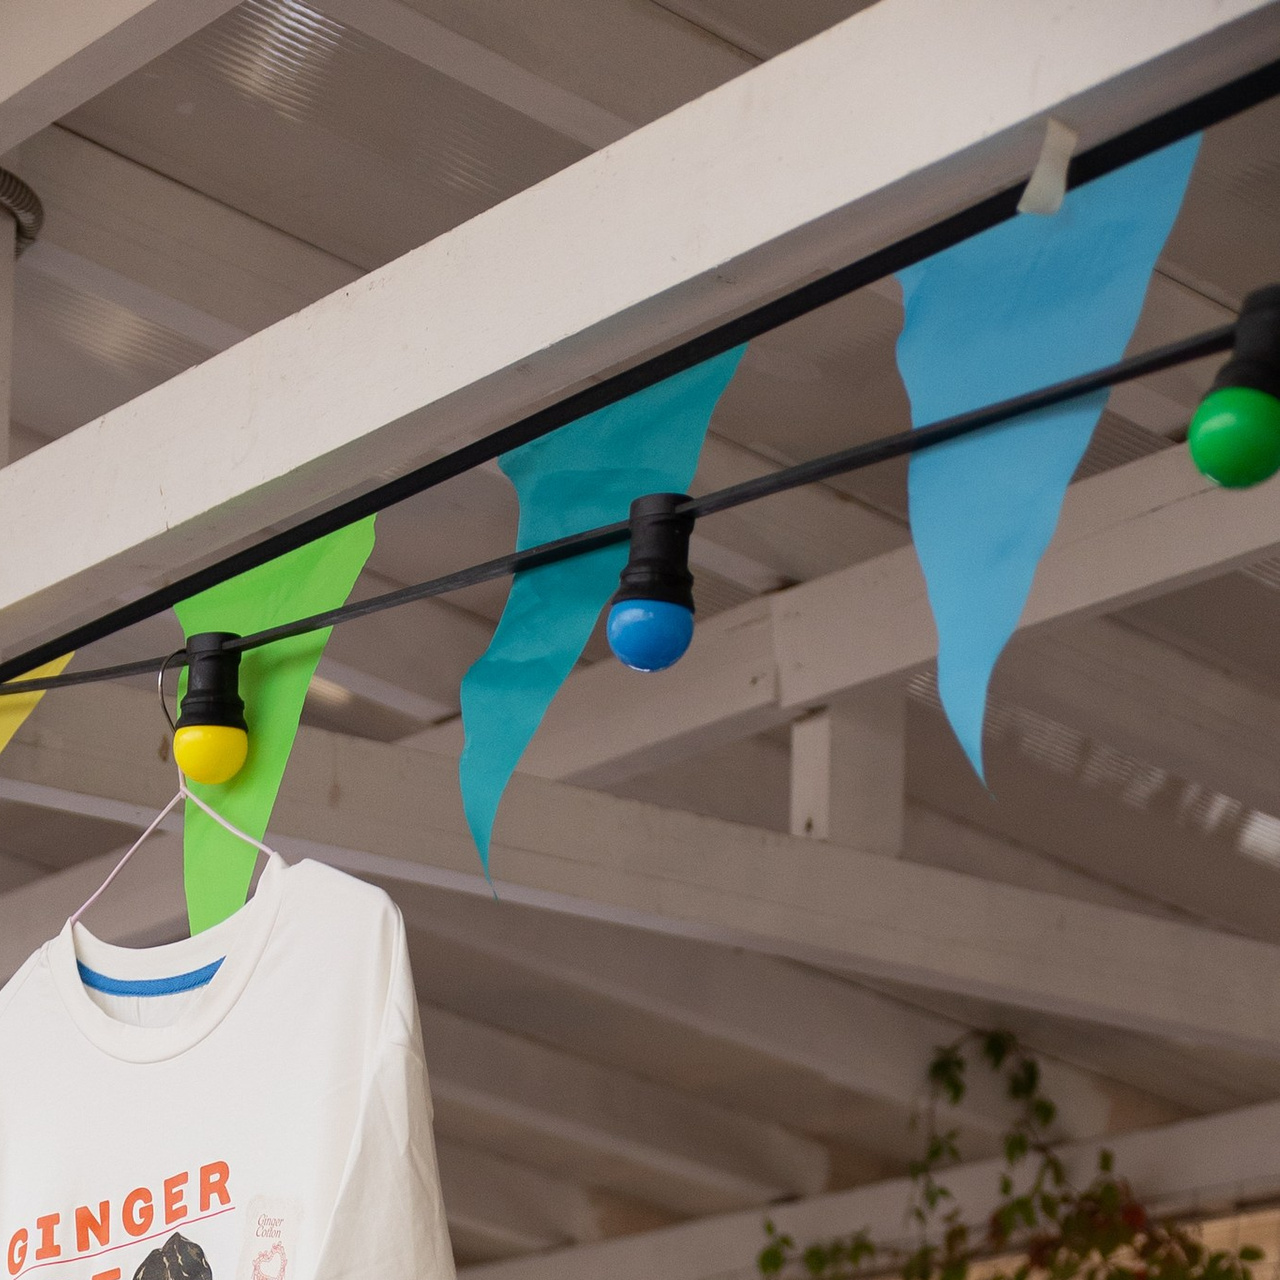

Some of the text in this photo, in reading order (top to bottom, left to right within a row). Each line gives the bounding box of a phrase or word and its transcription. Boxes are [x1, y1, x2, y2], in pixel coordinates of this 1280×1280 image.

[7, 1160, 232, 1276] GINGER
[258, 1213, 284, 1228] Ginger
[255, 1226, 282, 1239] Cotton
